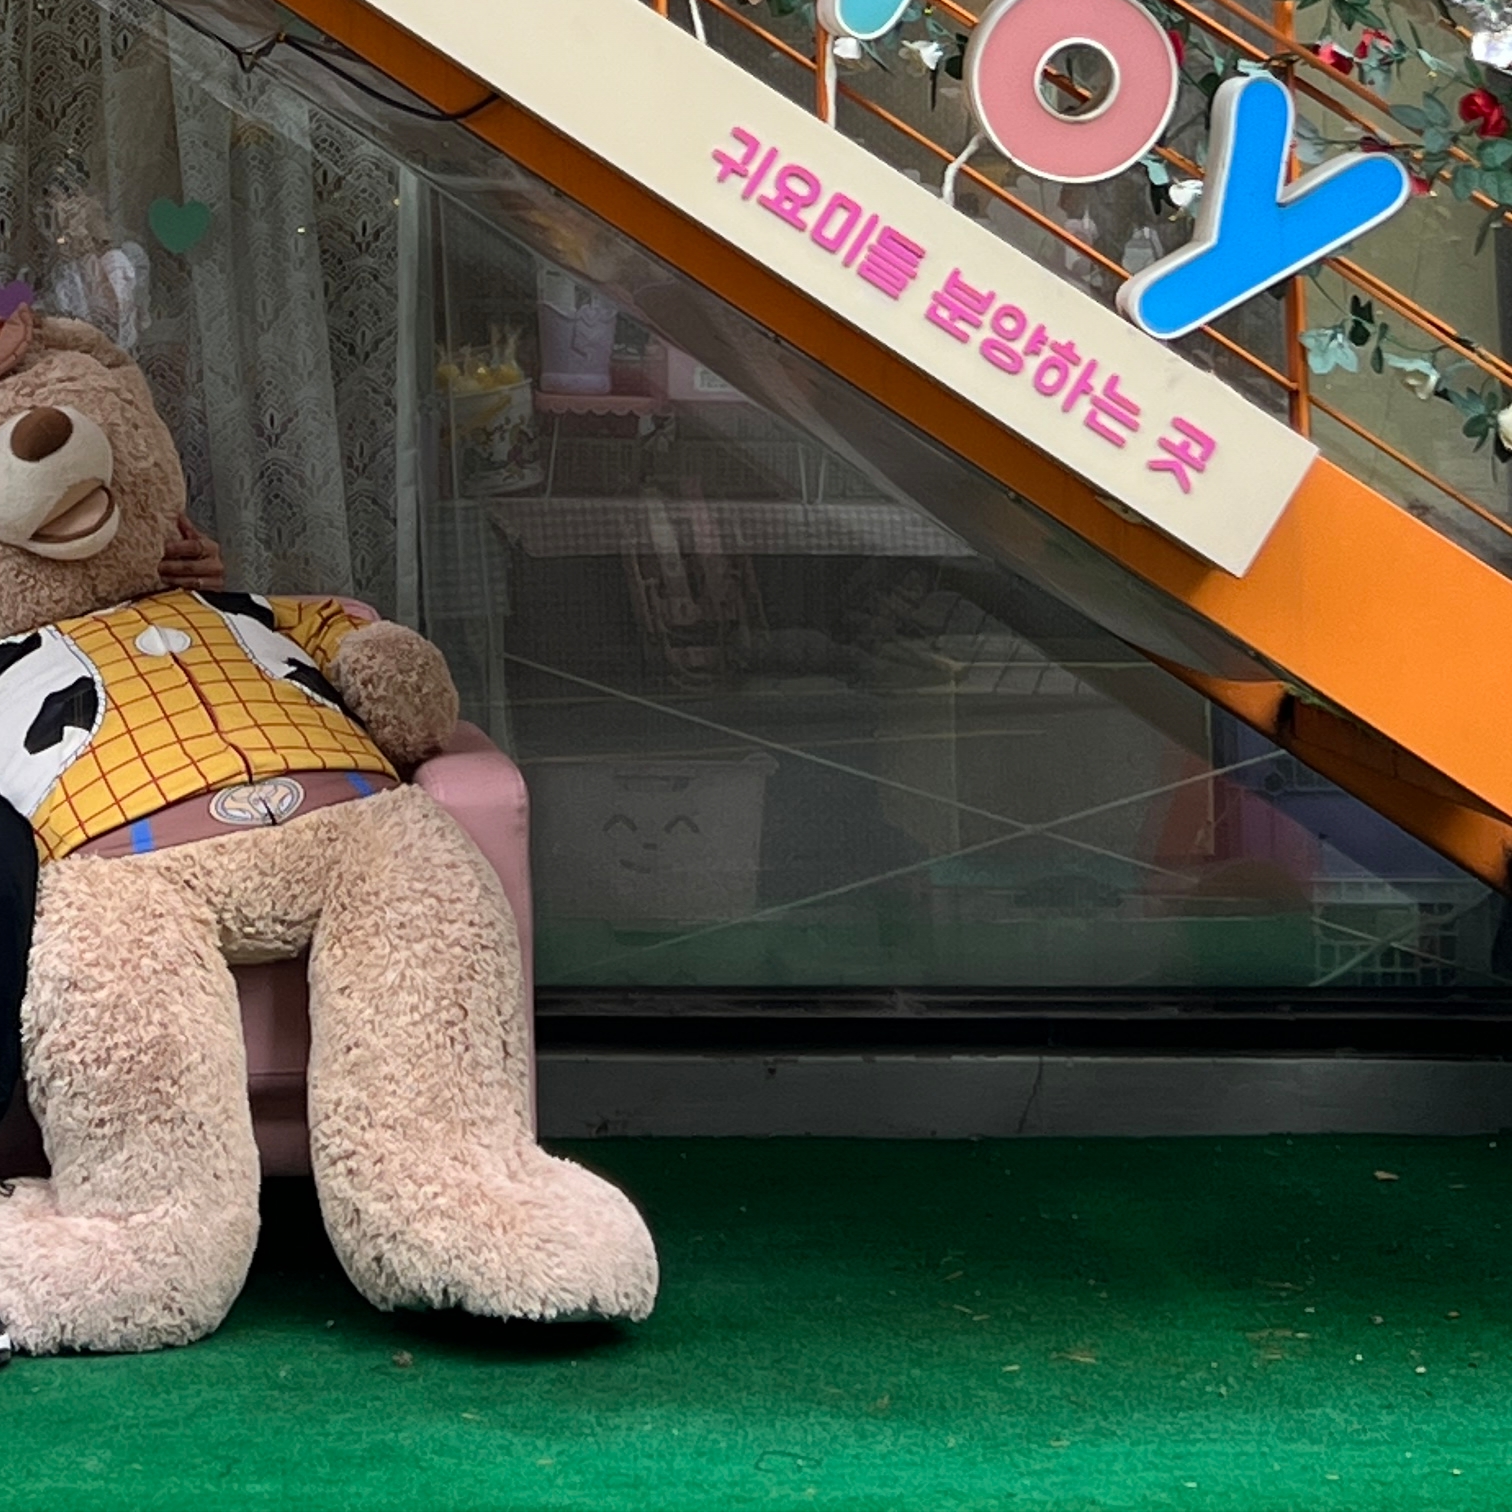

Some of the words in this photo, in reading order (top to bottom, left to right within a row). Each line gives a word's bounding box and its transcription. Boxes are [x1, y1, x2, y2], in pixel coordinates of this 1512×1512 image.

[712, 126, 926, 300] 귀요미를
[925, 268, 1141, 448] 분양하는
[1146, 416, 1217, 495] 곳
